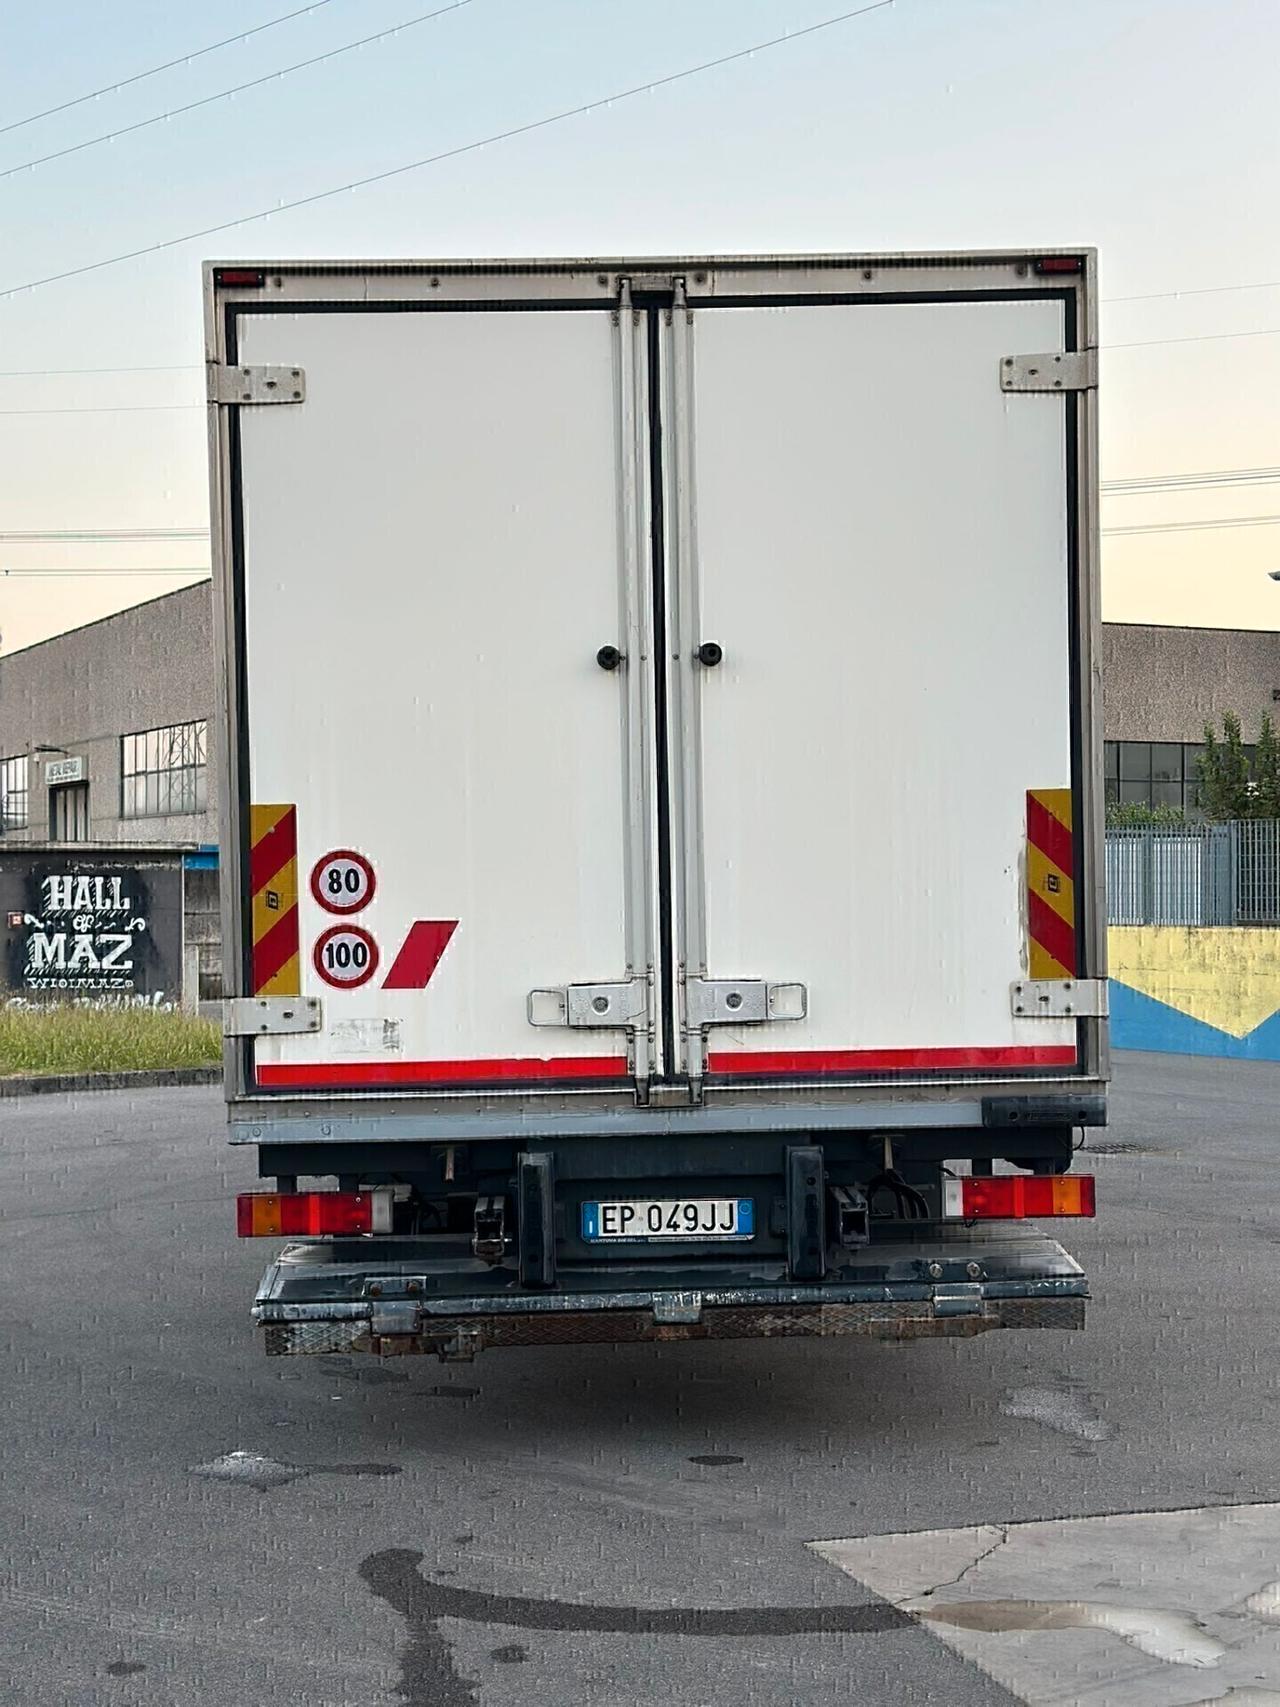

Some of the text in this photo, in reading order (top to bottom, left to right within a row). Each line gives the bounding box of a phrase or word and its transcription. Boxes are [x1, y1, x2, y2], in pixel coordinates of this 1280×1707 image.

[46, 875, 130, 911] HALL
[328, 868, 360, 894] 80
[32, 933, 133, 969] MAZ
[326, 942, 367, 968] 100
[602, 1203, 734, 1233] EP 049JJ
